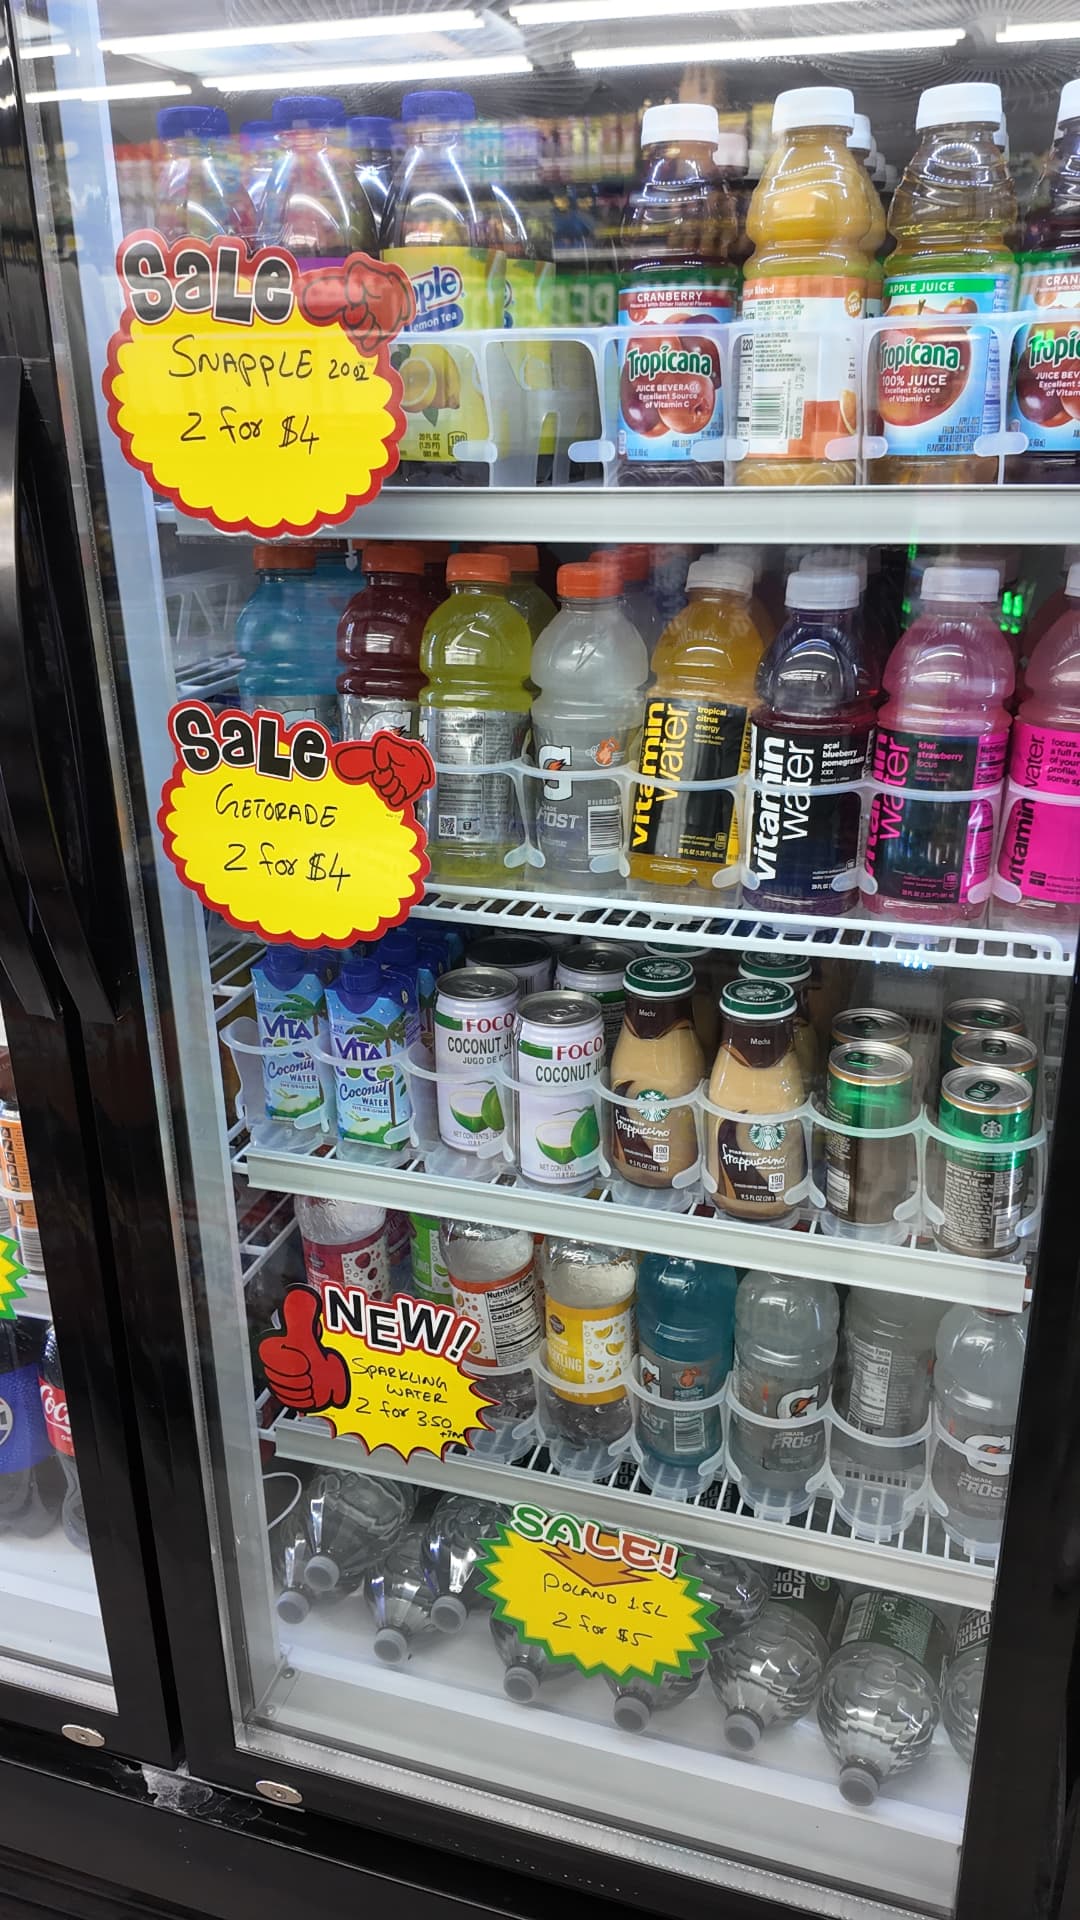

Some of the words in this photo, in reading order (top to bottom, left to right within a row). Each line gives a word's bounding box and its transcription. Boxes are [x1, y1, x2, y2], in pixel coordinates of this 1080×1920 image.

[889, 283, 916, 294] APPLE
[919, 281, 955, 292] JUICE
[637, 291, 703, 303] CRANBERRY
[441, 311, 457, 324] Tea
[880, 337, 960, 374] Tropicana
[627, 345, 712, 381] Tropicana
[882, 375, 905, 387] 100%
[907, 374, 947, 387] JUICE
[1036, 372, 1059, 381] JUICE
[636, 383, 655, 393] JUICE
[656, 382, 700, 393] BEVERAGE
[1039, 381, 1075, 389] Excellent
[639, 392, 670, 401] Excellent
[671, 391, 698, 400] Source
[645, 401, 653, 409] of
[654, 399, 683, 409] Vitamin
[180, 412, 206, 442] 2
[219, 406, 262, 443] for
[279, 415, 320, 454] $4
[697, 706, 728, 716] tropical
[696, 715, 719, 724] citrus
[695, 724, 720, 733] energy
[918, 741, 938, 751] kiwi
[1057, 748, 1072, 757] full
[822, 750, 857, 759] blueberry
[917, 751, 964, 762] strawberry
[1049, 756, 1059, 764] of
[916, 760, 939, 769] focus
[632, 702, 665, 847] vitamin
[1046, 775, 1070, 785] some
[879, 736, 910, 840] water
[223, 843, 248, 871] 2
[259, 842, 298, 875] for
[306, 852, 351, 892] $4
[262, 1014, 313, 1041] VITA
[466, 1013, 515, 1034] FOCO
[334, 1036, 383, 1061] VITA
[447, 1035, 502, 1055] COCONUT
[556, 1036, 603, 1061] FOCO
[267, 1056, 315, 1079] Coconut
[462, 1056, 485, 1065] JUGO
[486, 1056, 497, 1064] DE
[289, 1074, 318, 1083] WATER
[535, 1062, 592, 1083] COCONUT
[340, 1079, 388, 1101] Coconut
[361, 1097, 389, 1107] WATER
[722, 1143, 787, 1172] frappuccino
[486, 1286, 519, 1299] Nutrition
[491, 1307, 523, 1321] Calories
[326, 1288, 474, 1360] NEW!
[351, 1357, 448, 1393] SPARKLING
[386, 1383, 448, 1404] WATER
[355, 1397, 371, 1415] 2
[379, 1401, 409, 1418] for
[416, 1410, 452, 1429] 3.50
[771, 1430, 823, 1451] FROST
[956, 1478, 1008, 1498] FROS
[511, 1504, 677, 1577] SALE!
[552, 1612, 571, 1629] 2
[579, 1615, 607, 1635] for
[616, 1629, 653, 1647] $5
